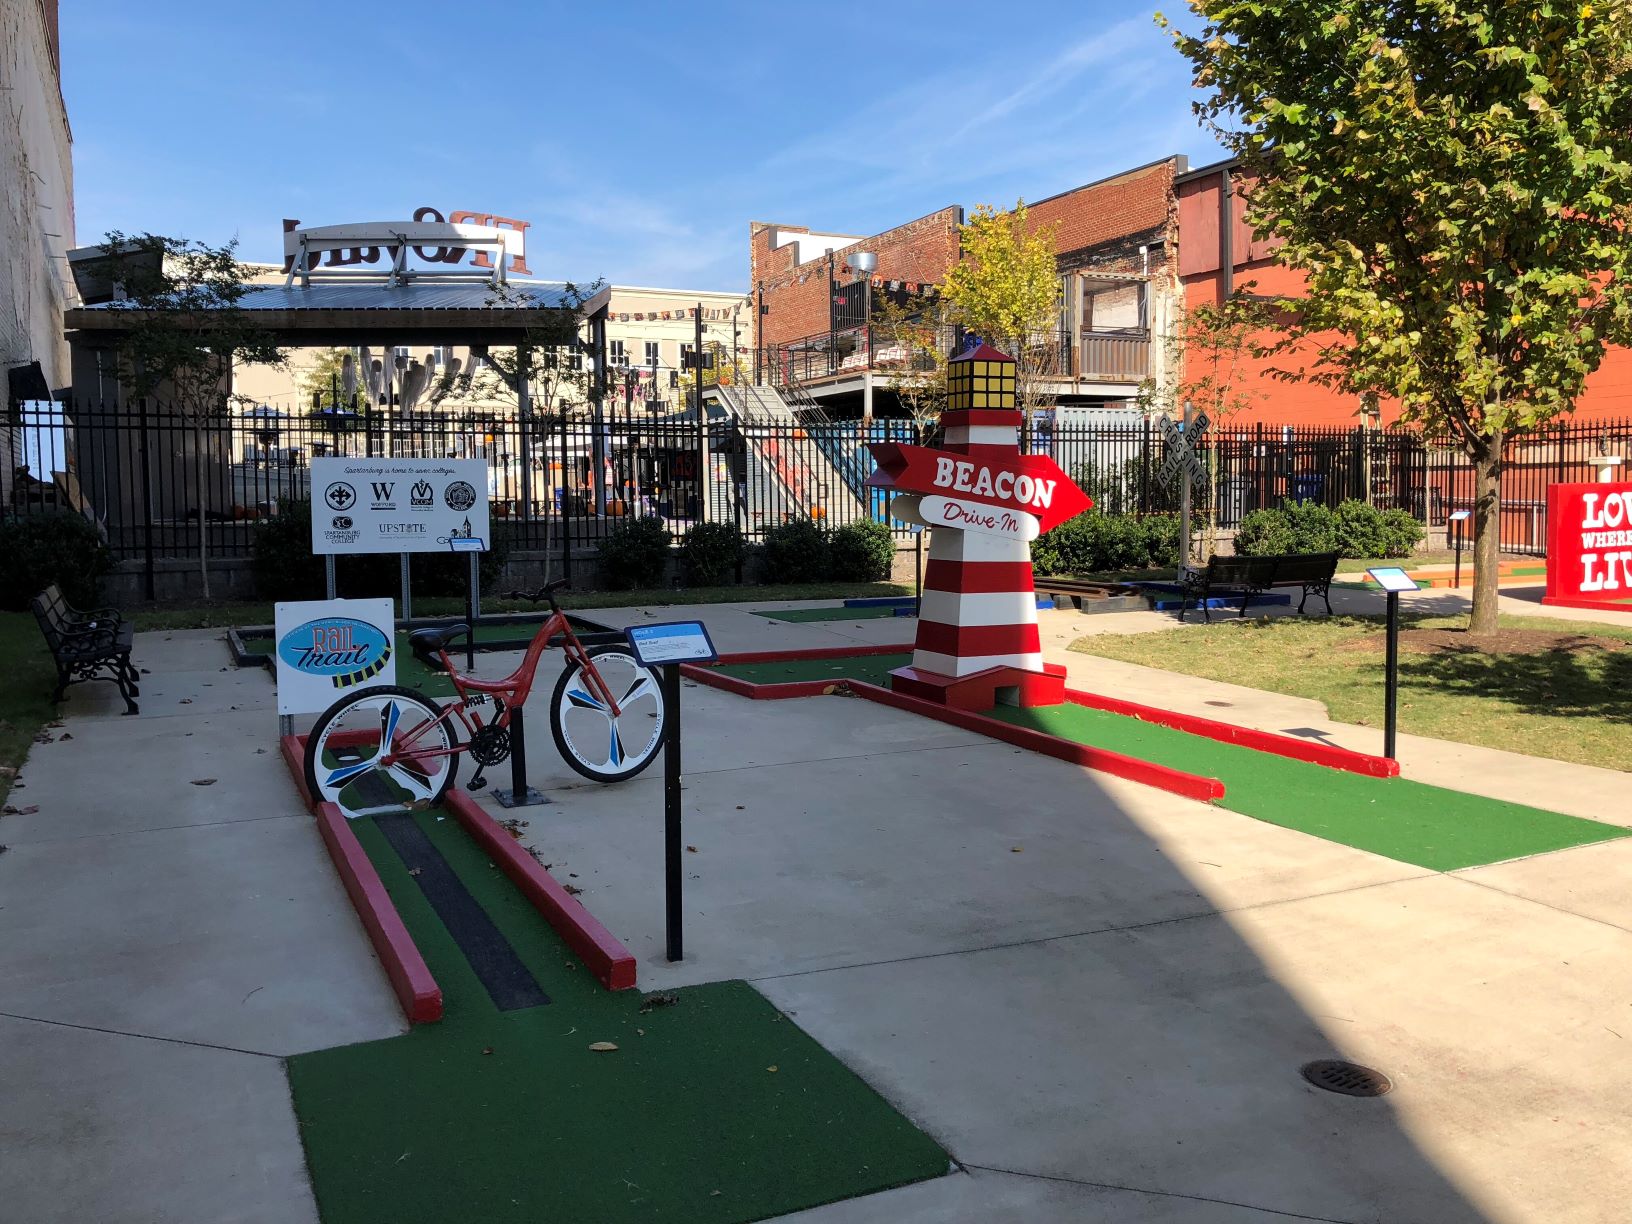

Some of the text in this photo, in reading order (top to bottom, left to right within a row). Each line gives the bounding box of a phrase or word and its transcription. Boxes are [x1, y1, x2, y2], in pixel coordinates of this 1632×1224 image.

[344, 466, 383, 476] Spartanburg
[933, 457, 1057, 509] BEACON
[370, 482, 396, 501] W
[943, 502, 1019, 533] Drive-In
[290, 643, 370, 668] Trail
